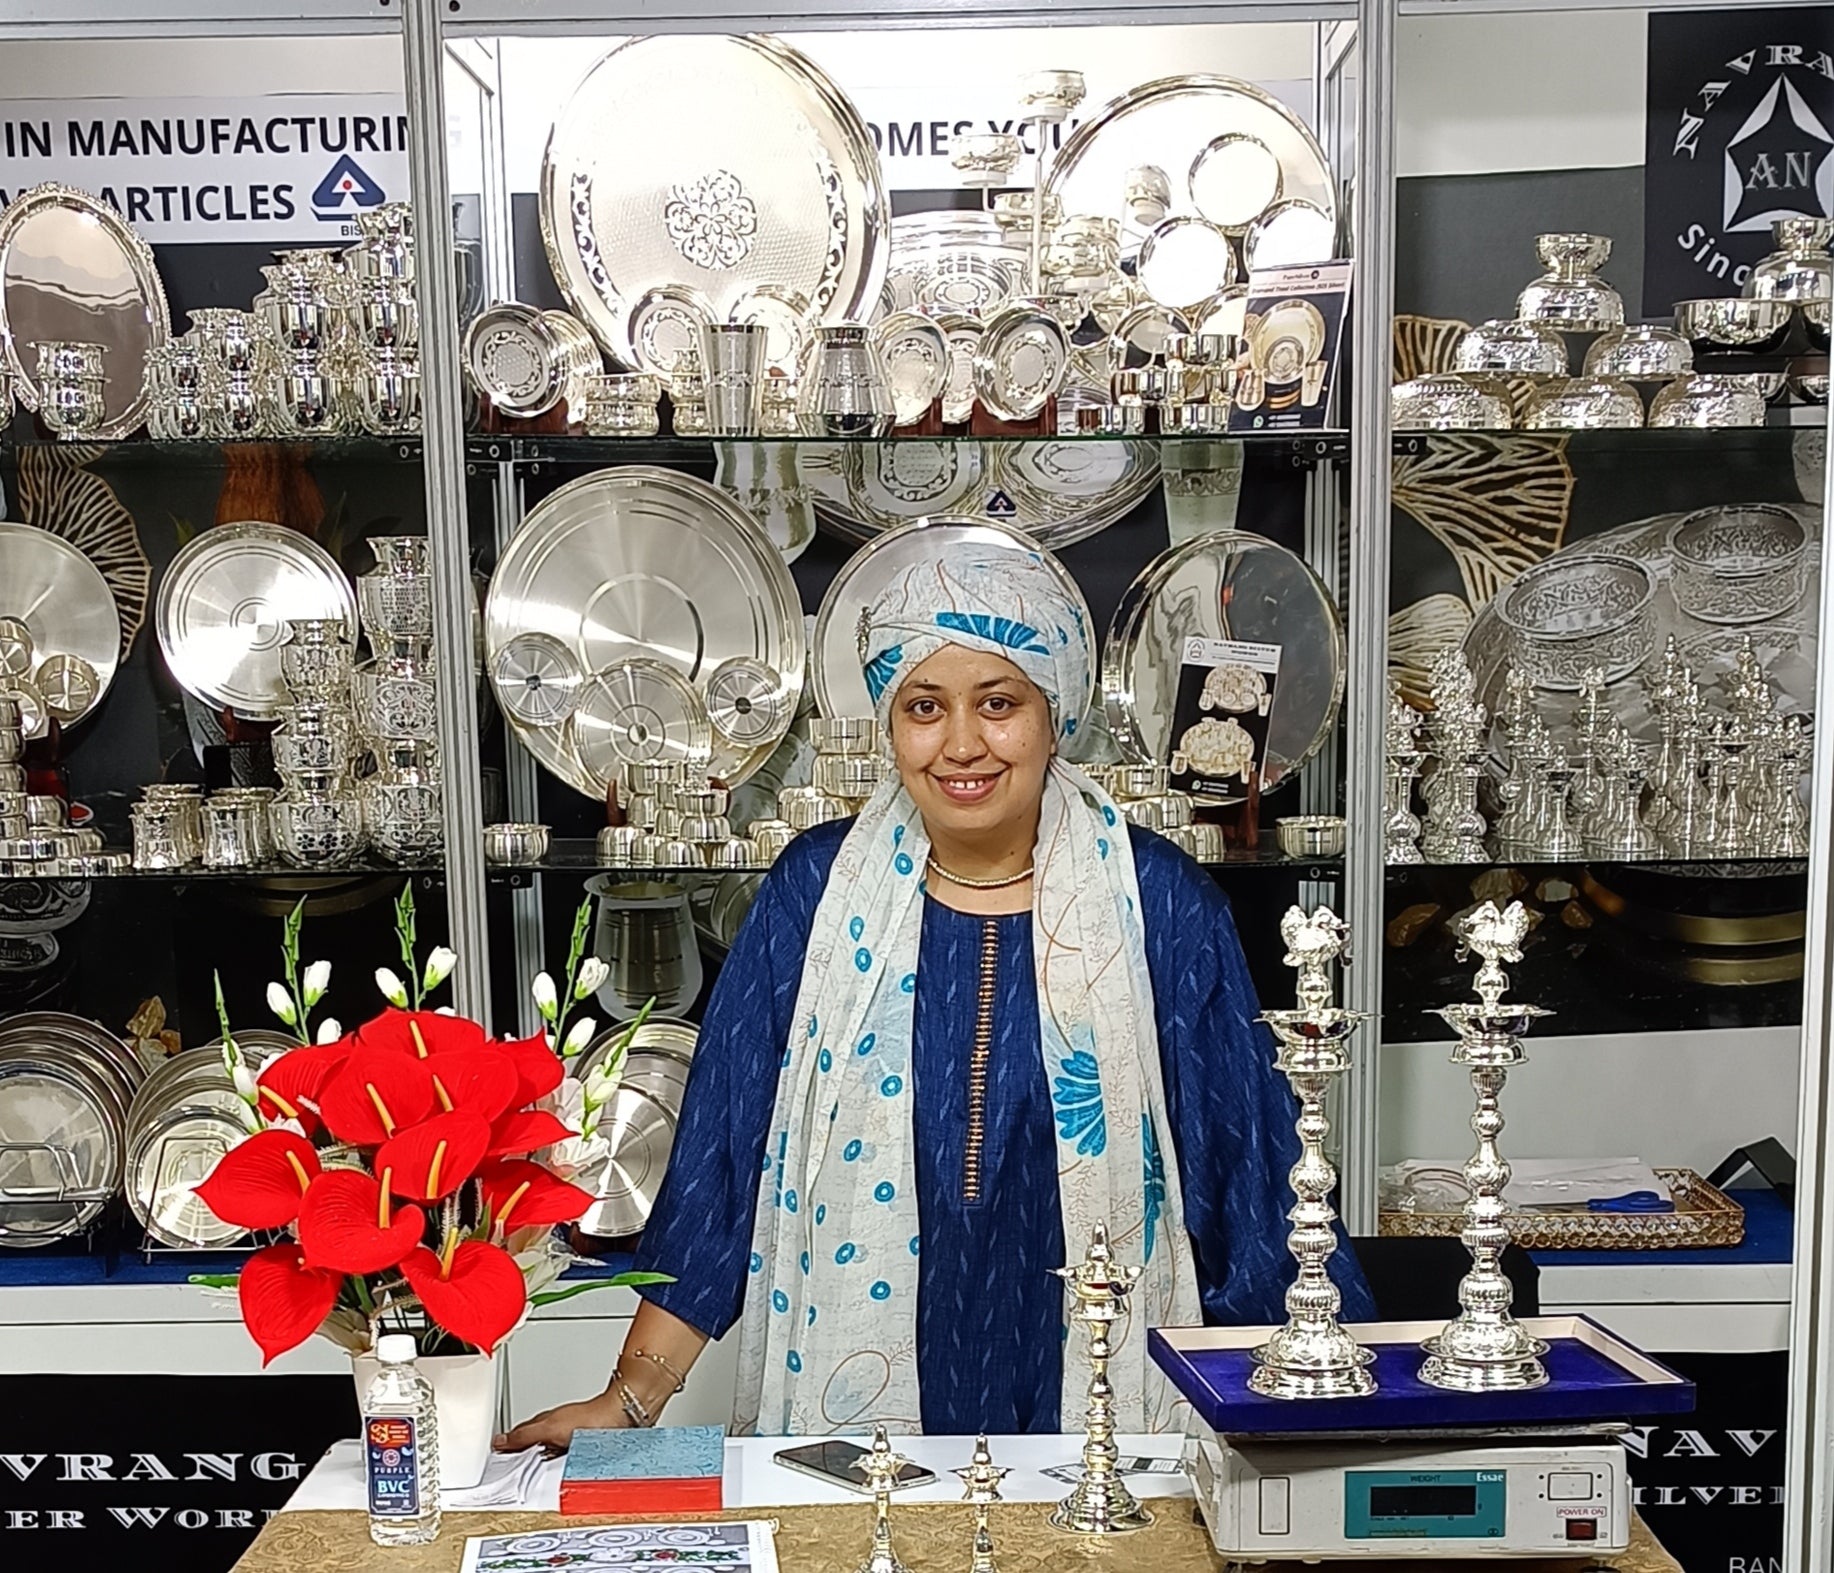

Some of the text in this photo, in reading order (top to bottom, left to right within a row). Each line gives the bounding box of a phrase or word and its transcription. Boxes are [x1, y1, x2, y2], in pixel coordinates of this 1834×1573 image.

[5, 121, 53, 158] IN
[1744, 151, 1811, 190] AN
[0, 1452, 306, 1482] VRANG
[1476, 1472, 1504, 1482] Essae
[377, 1480, 410, 1493] BVC
[1633, 1486, 1785, 1506] ILVE
[5, 1507, 282, 1529] ER WOR
[1558, 1508, 1604, 1516] POWER ON
